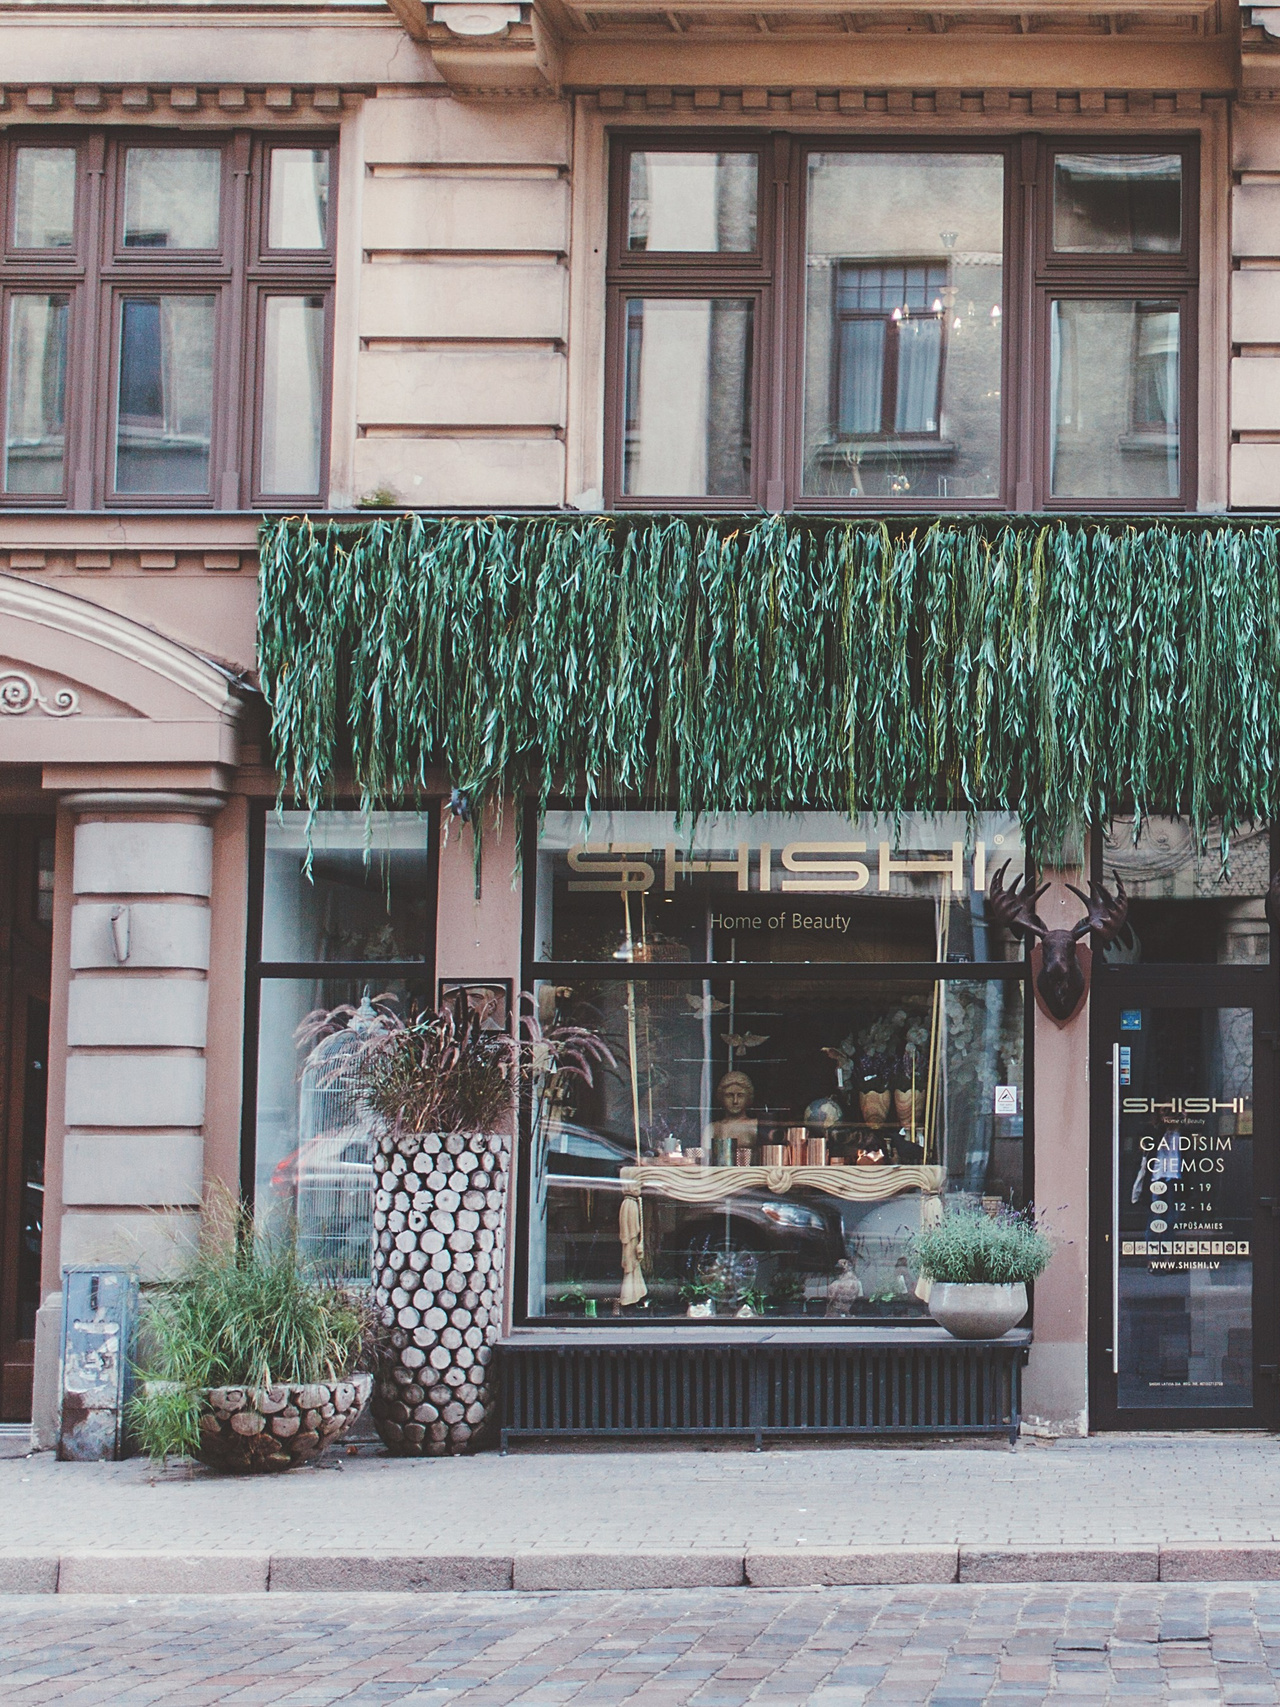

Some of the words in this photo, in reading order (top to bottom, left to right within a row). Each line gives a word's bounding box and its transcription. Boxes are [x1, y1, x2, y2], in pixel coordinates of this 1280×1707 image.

[711, 913, 762, 930] Home
[768, 911, 787, 930] of
[793, 913, 851, 934] Beauty
[1123, 1097, 1244, 1113] SHISHI
[1139, 1133, 1232, 1151] GAIDĪSIM
[1146, 1157, 1225, 1173] CIEMOS
[1173, 1183, 1185, 1192] 11
[1199, 1183, 1212, 1192] 19
[1174, 1202, 1186, 1211] 12
[1200, 1202, 1212, 1211] 16
[1151, 1261, 1220, 1269] WWW.SHISHI.LV
